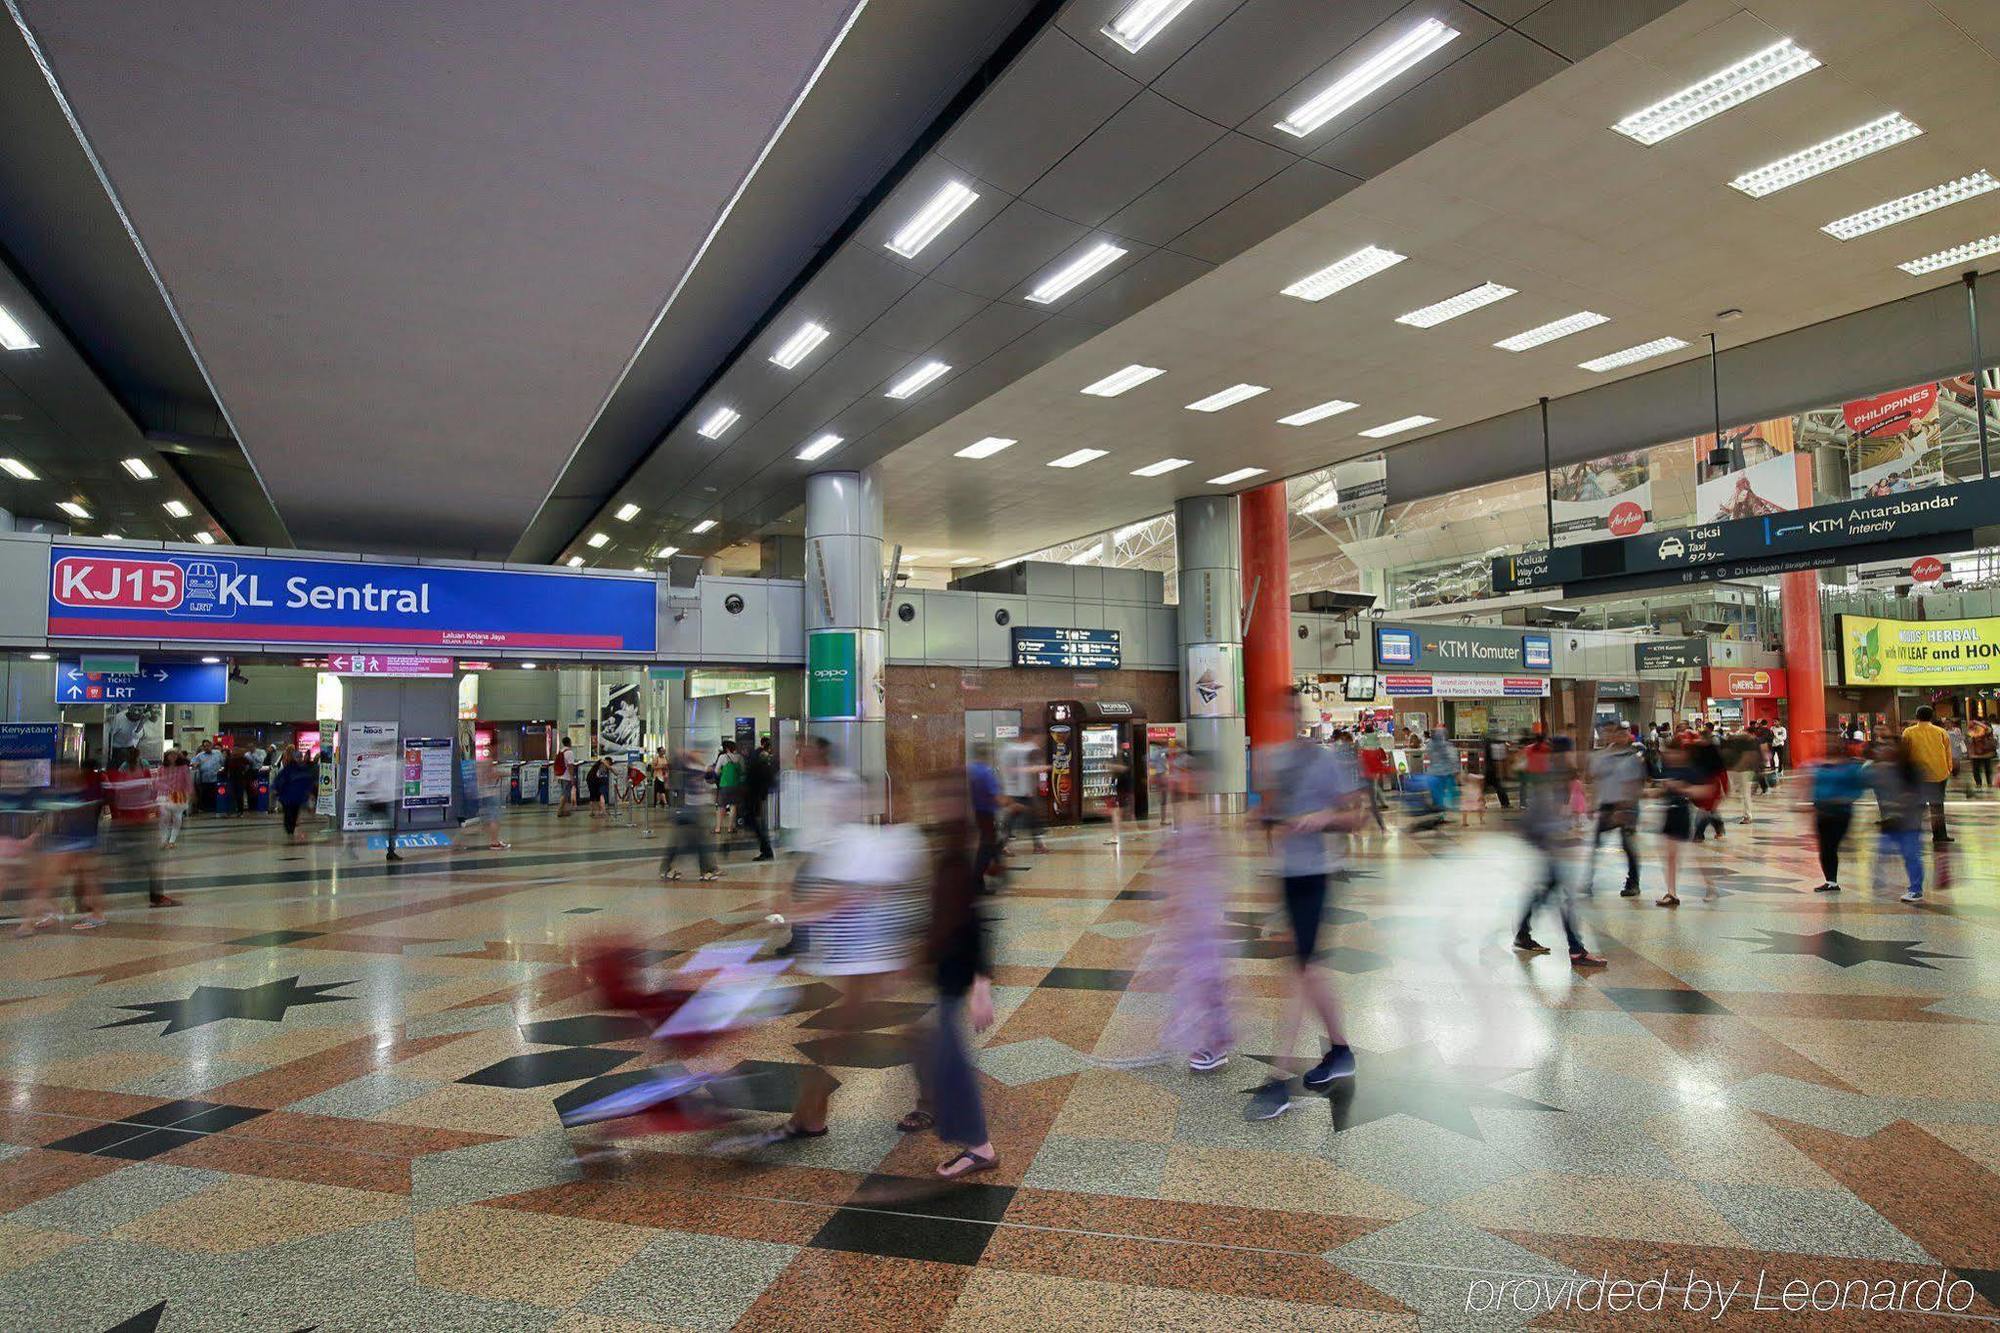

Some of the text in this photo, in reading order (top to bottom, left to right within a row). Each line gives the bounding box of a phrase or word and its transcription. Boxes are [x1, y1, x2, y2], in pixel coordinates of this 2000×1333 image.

[1854, 389, 1929, 426] PHILIPPINES
[1849, 494, 1959, 522] Antarabandar
[1809, 518, 1844, 535] KTM
[1849, 519, 1896, 535] Intercity
[1689, 527, 1721, 540] Teksi
[1688, 543, 1706, 552] Taxi
[1516, 555, 1548, 567] Keluar
[1689, 552, 1724, 562] タクシー
[1517, 566, 1548, 578] Way Out
[1734, 564, 1744, 576] Di
[1745, 562, 1780, 575] Hadapan
[1785, 560, 1811, 570] Straight
[1813, 557, 1836, 566] Ahead
[62, 565, 176, 603] KJ15
[219, 573, 430, 614] KL Sentral
[189, 603, 213, 612] LRT
[466, 632, 489, 640] Kelana
[490, 633, 506, 642] Jaya
[1926, 628, 1981, 643] HERBAL
[1439, 640, 1519, 660] KTM Komuter
[1908, 646, 1928, 660] LEAF
[1932, 646, 1960, 660] and
[814, 669, 848, 678] oppo
[1731, 679, 1763, 691] myNEWS.com
[106, 687, 136, 698] LRT
[1, 725, 53, 735] Kenyataan
